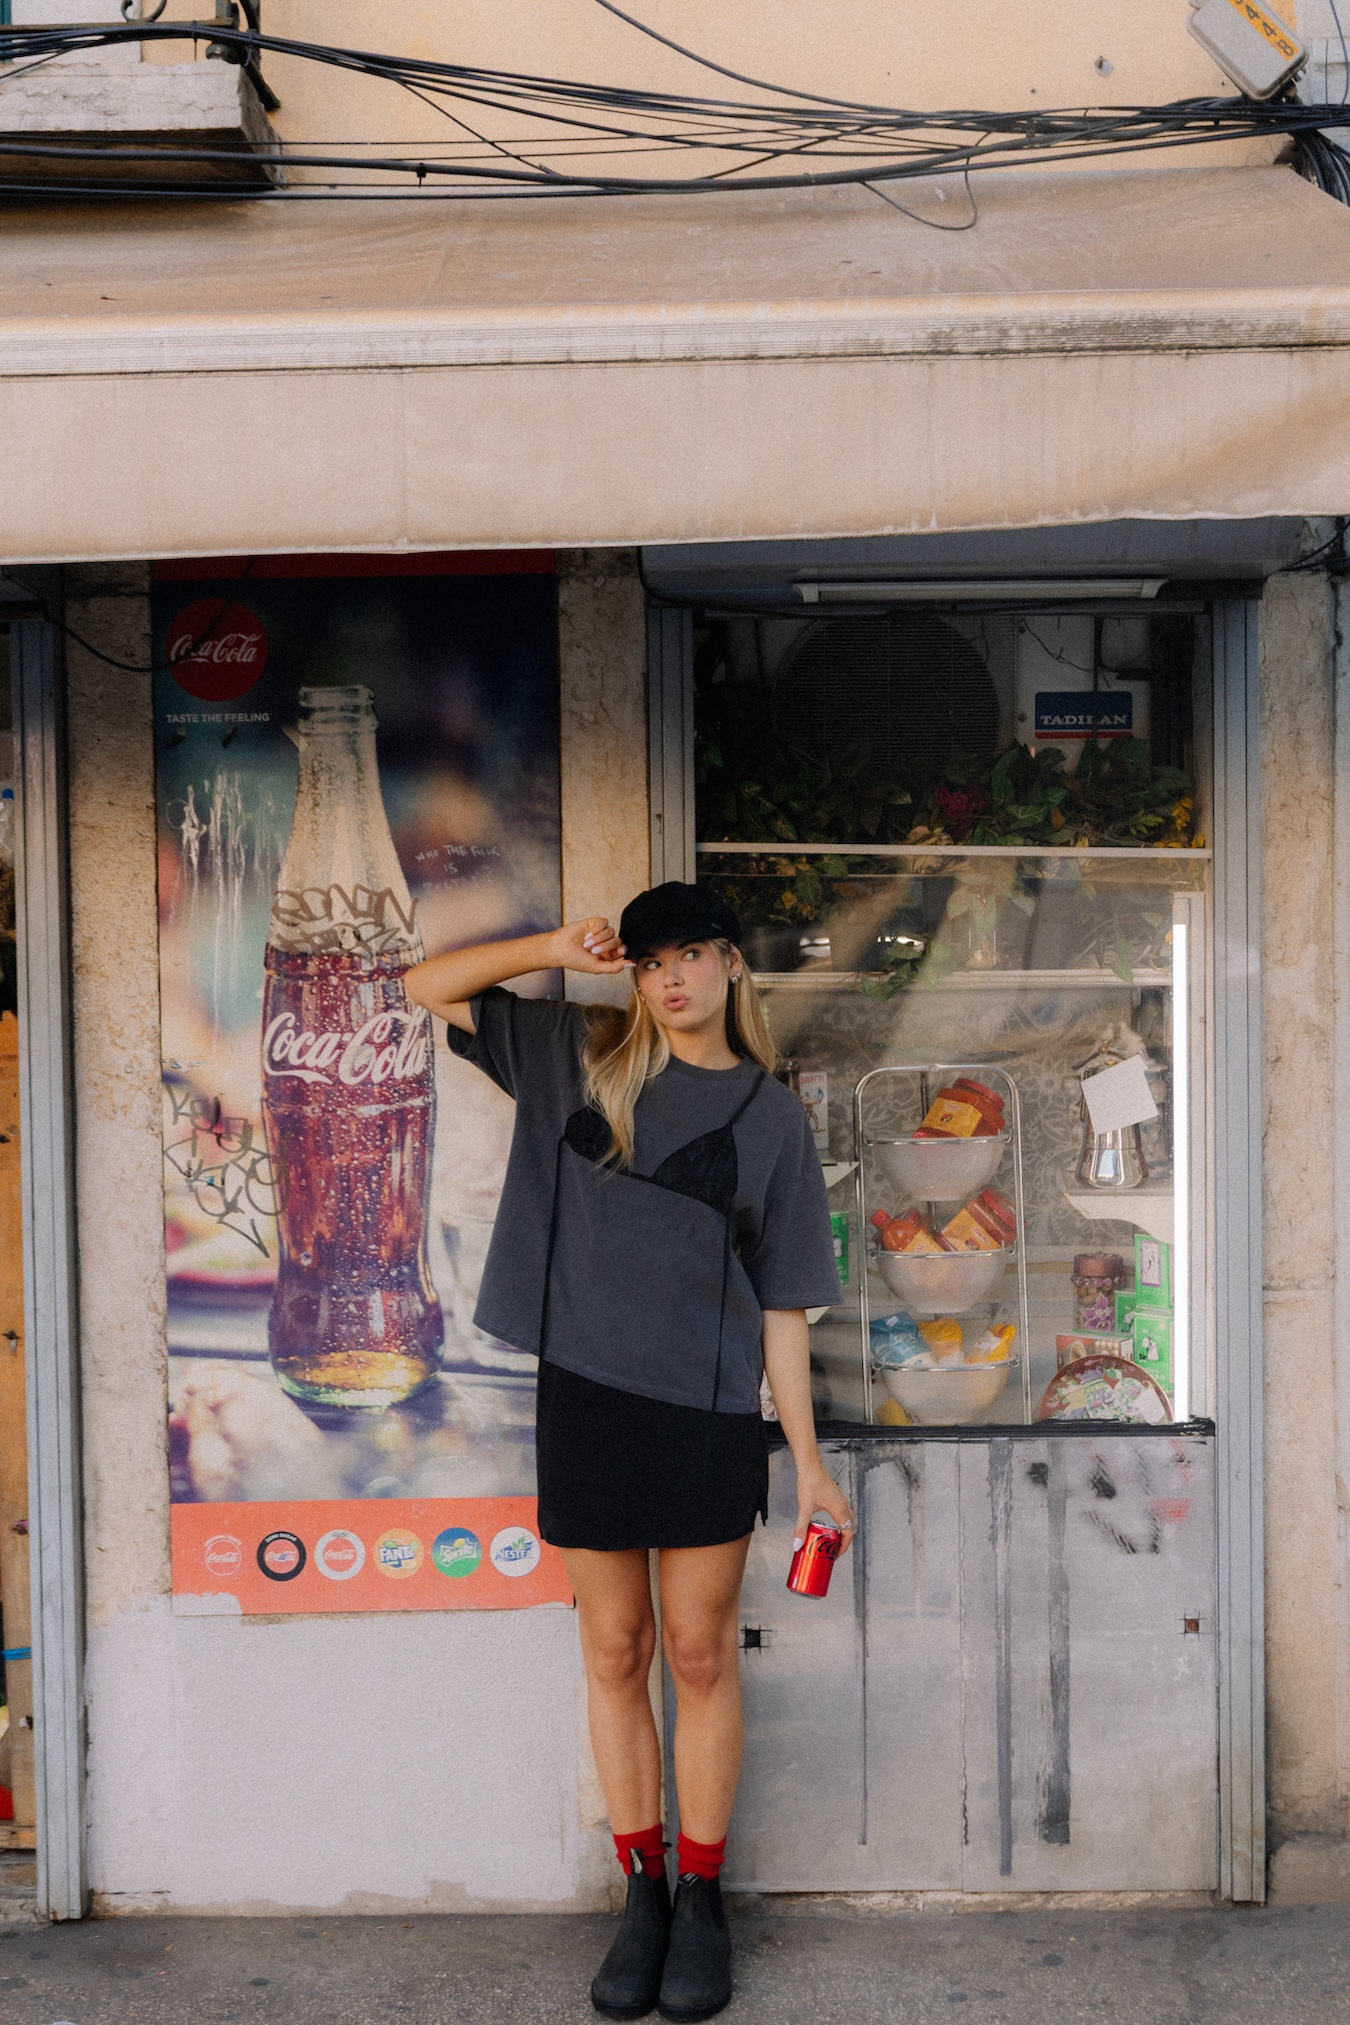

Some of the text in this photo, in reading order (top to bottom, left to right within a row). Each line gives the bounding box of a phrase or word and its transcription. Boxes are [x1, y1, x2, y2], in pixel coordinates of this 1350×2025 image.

[171, 633, 261, 663] Coa-Cola
[166, 713, 270, 723] TASTE THE FEELING
[415, 845, 500, 861] WHO THE FUCK
[444, 862, 458, 873] IS
[264, 1004, 427, 1085] Coca-Cola
[378, 1545, 415, 1563] FANTA
[441, 1542, 474, 1563] Sprite
